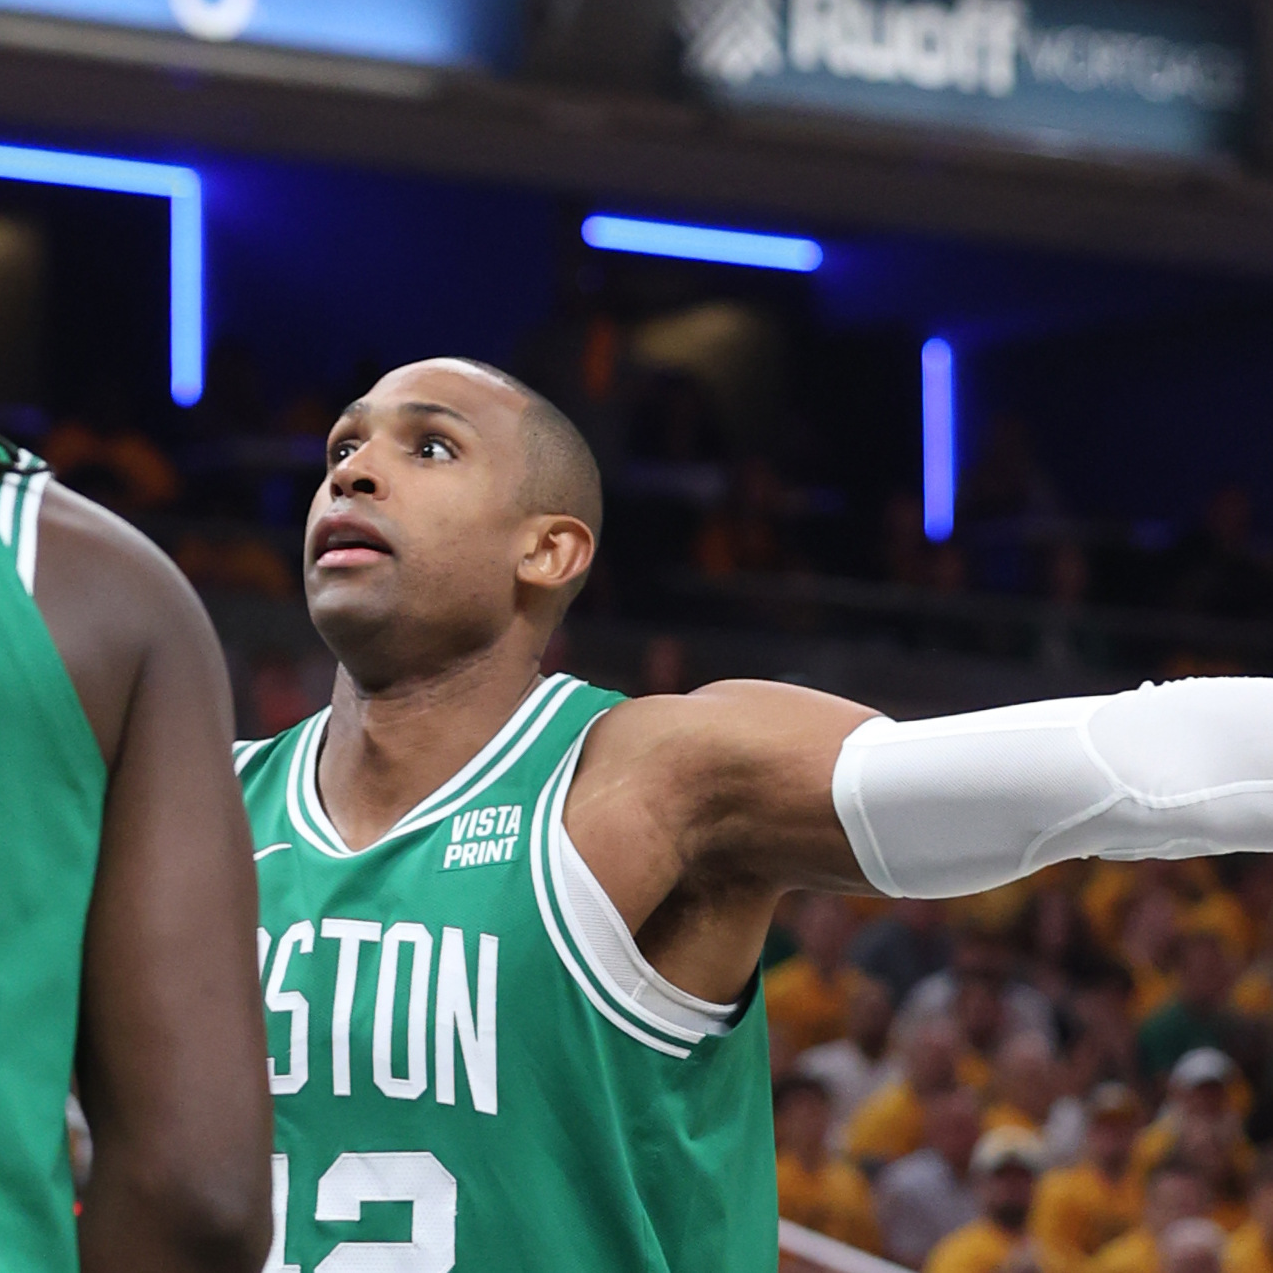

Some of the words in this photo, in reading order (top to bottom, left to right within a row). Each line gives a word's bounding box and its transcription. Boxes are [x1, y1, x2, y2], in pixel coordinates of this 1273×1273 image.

[443, 835, 519, 869] PRINT
[451, 804, 523, 843] VISTA
[257, 918, 499, 1116] STON
[262, 1151, 457, 1273] 2
